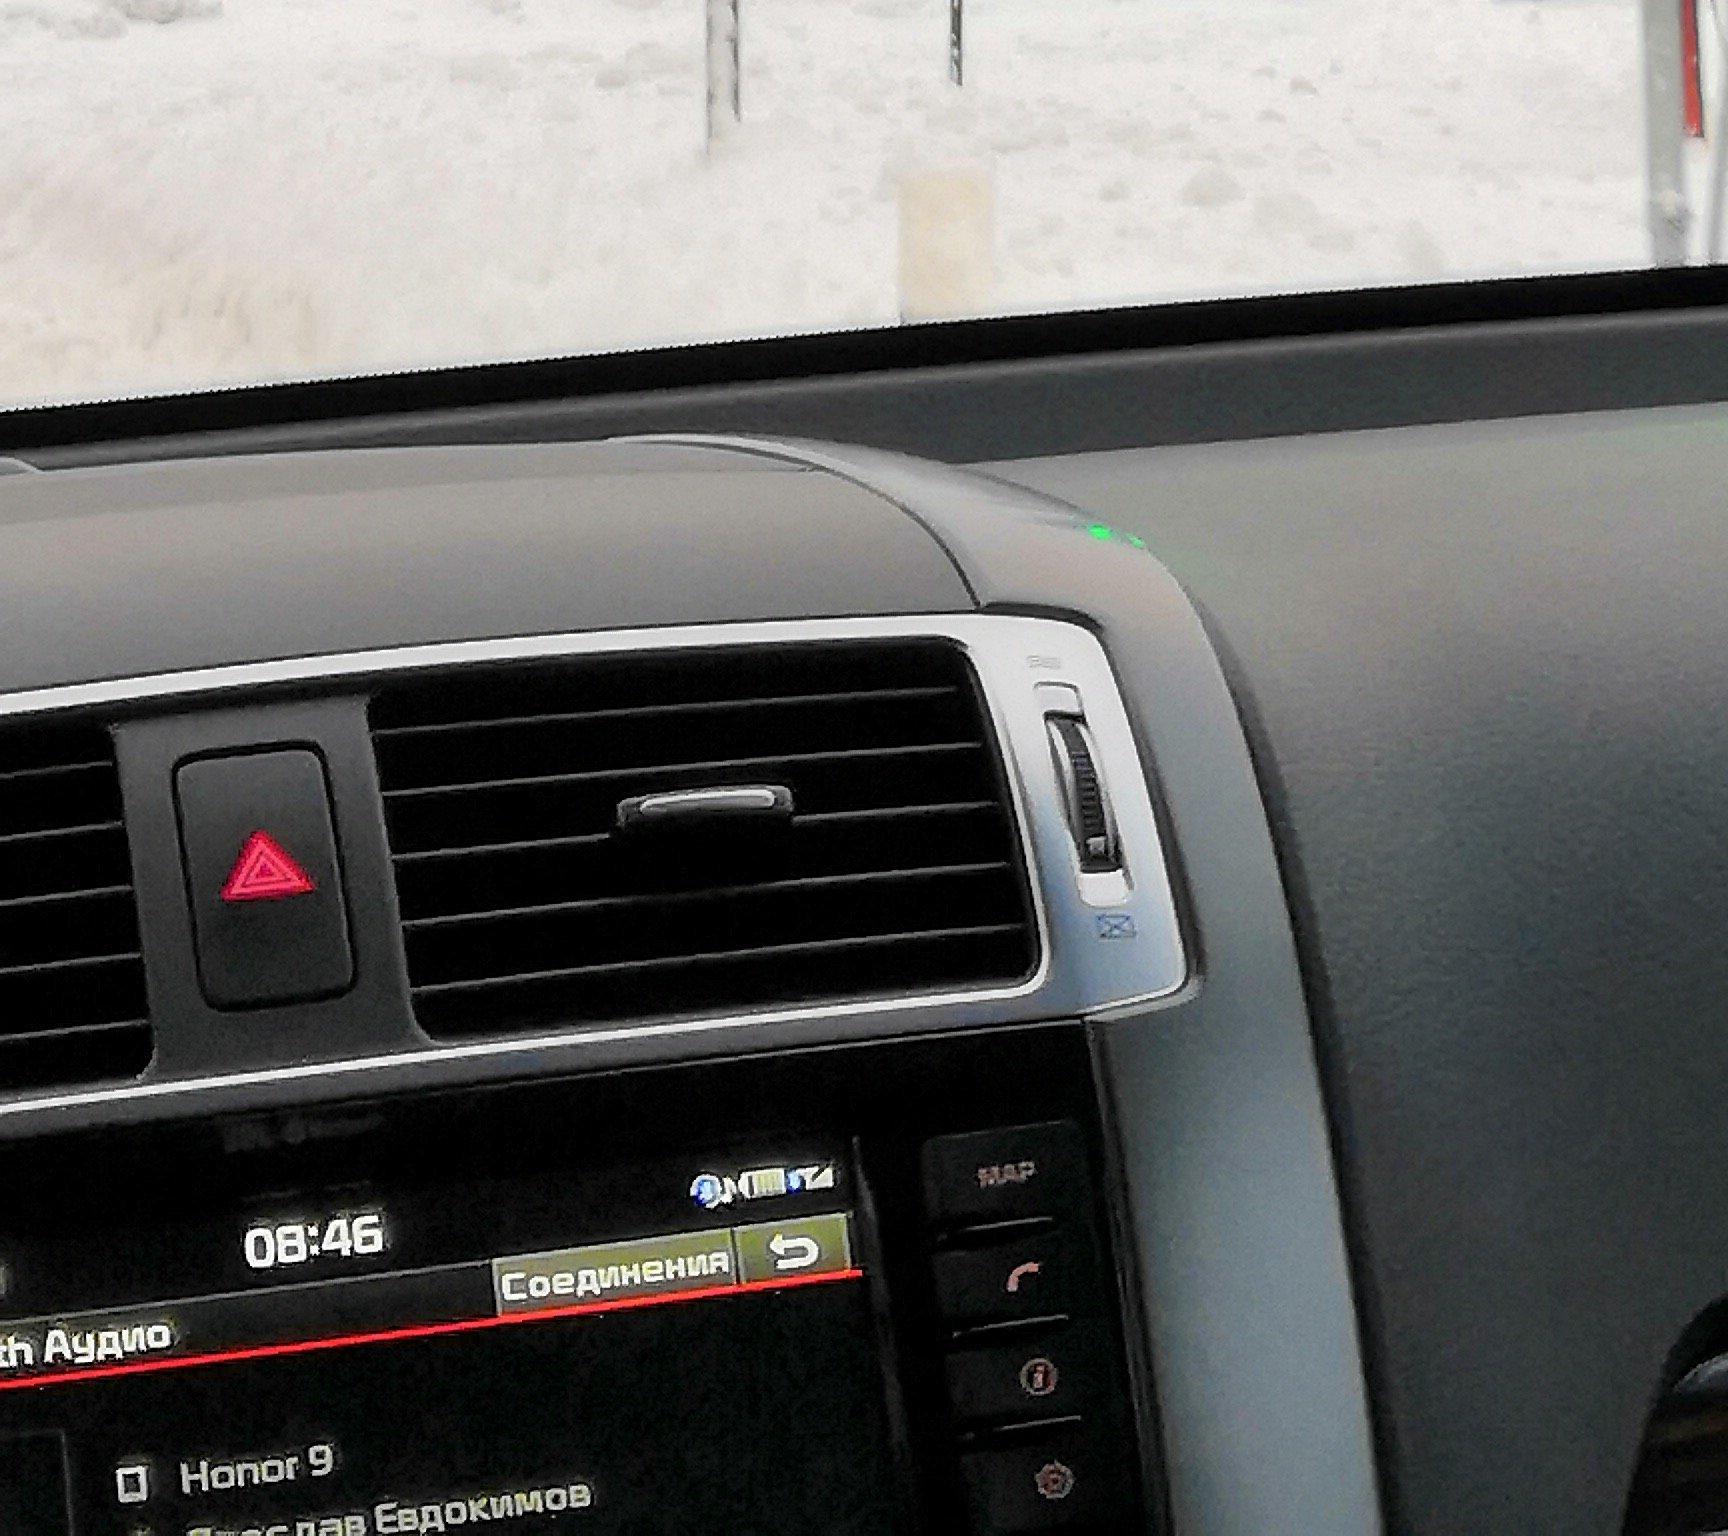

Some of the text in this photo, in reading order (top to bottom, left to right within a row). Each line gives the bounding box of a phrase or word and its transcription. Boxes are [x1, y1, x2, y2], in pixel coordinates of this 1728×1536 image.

[977, 1161, 1037, 1188] MAP
[243, 1212, 387, 1270] 08:46
[501, 1249, 732, 1302] Соединения
[43, 1324, 173, 1364] Аудио
[180, 1443, 335, 1495] Honor 9
[373, 1482, 593, 1535] Евдокимов
